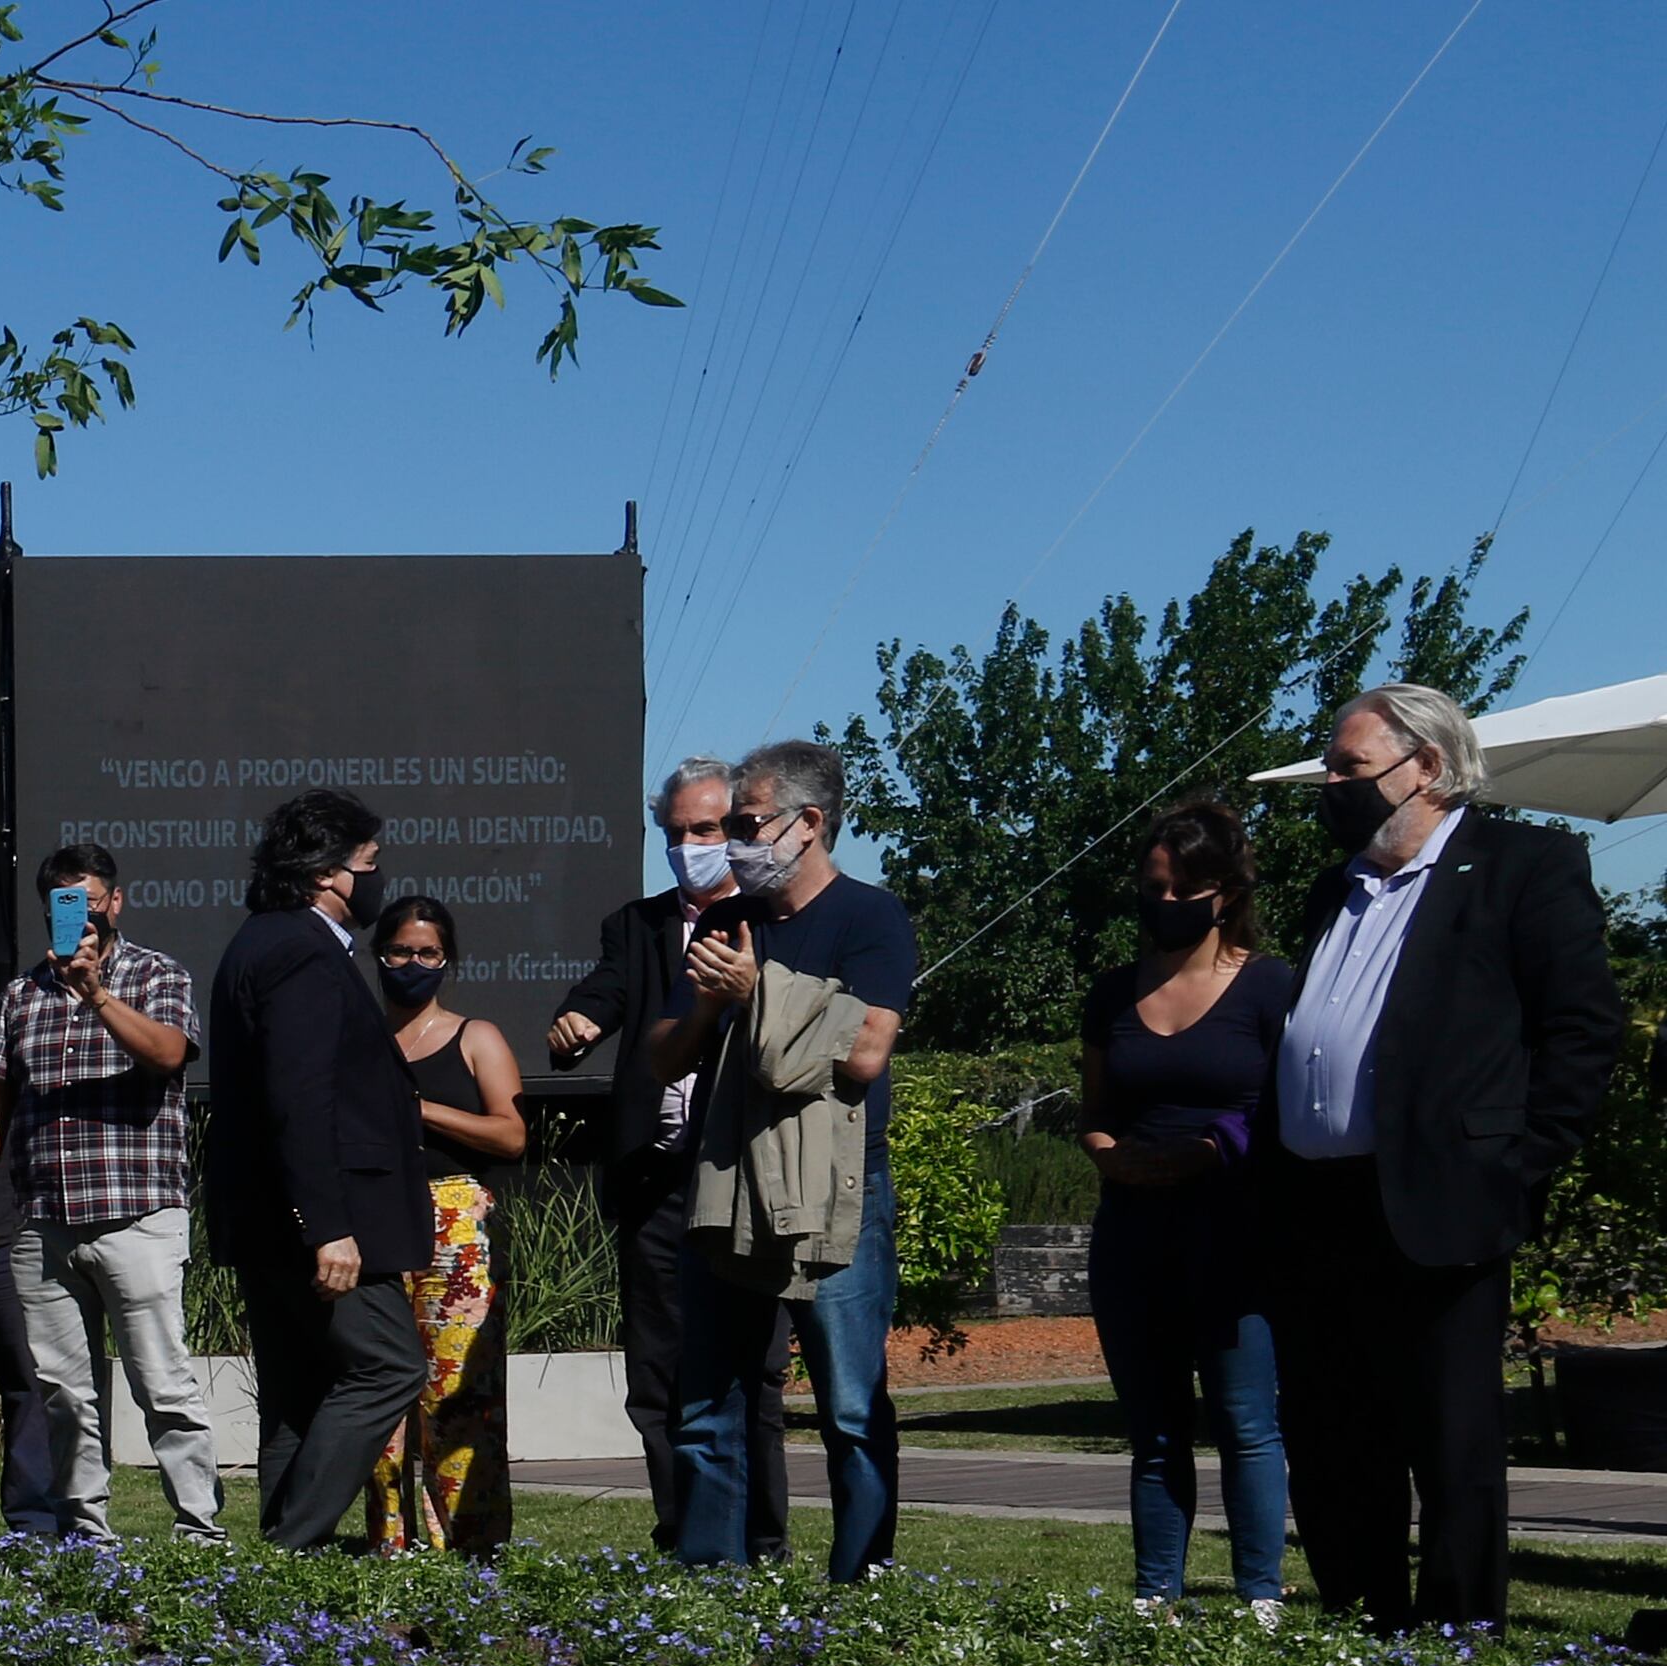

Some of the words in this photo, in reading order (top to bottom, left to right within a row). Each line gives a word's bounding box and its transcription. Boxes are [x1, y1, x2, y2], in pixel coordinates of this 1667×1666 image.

[213, 759, 230, 788] A
[238, 757, 422, 788] PROPONERLES
[429, 756, 466, 786] UN
[473, 748, 566, 786] SUEÑO:
[59, 819, 238, 849] RECONSTRUIR
[384, 816, 462, 846] ROPIA
[469, 815, 613, 849] IDENTIDAD,
[127, 880, 205, 909] COMO
[456, 952, 502, 983] stor
[507, 951, 599, 982] Kirchne
